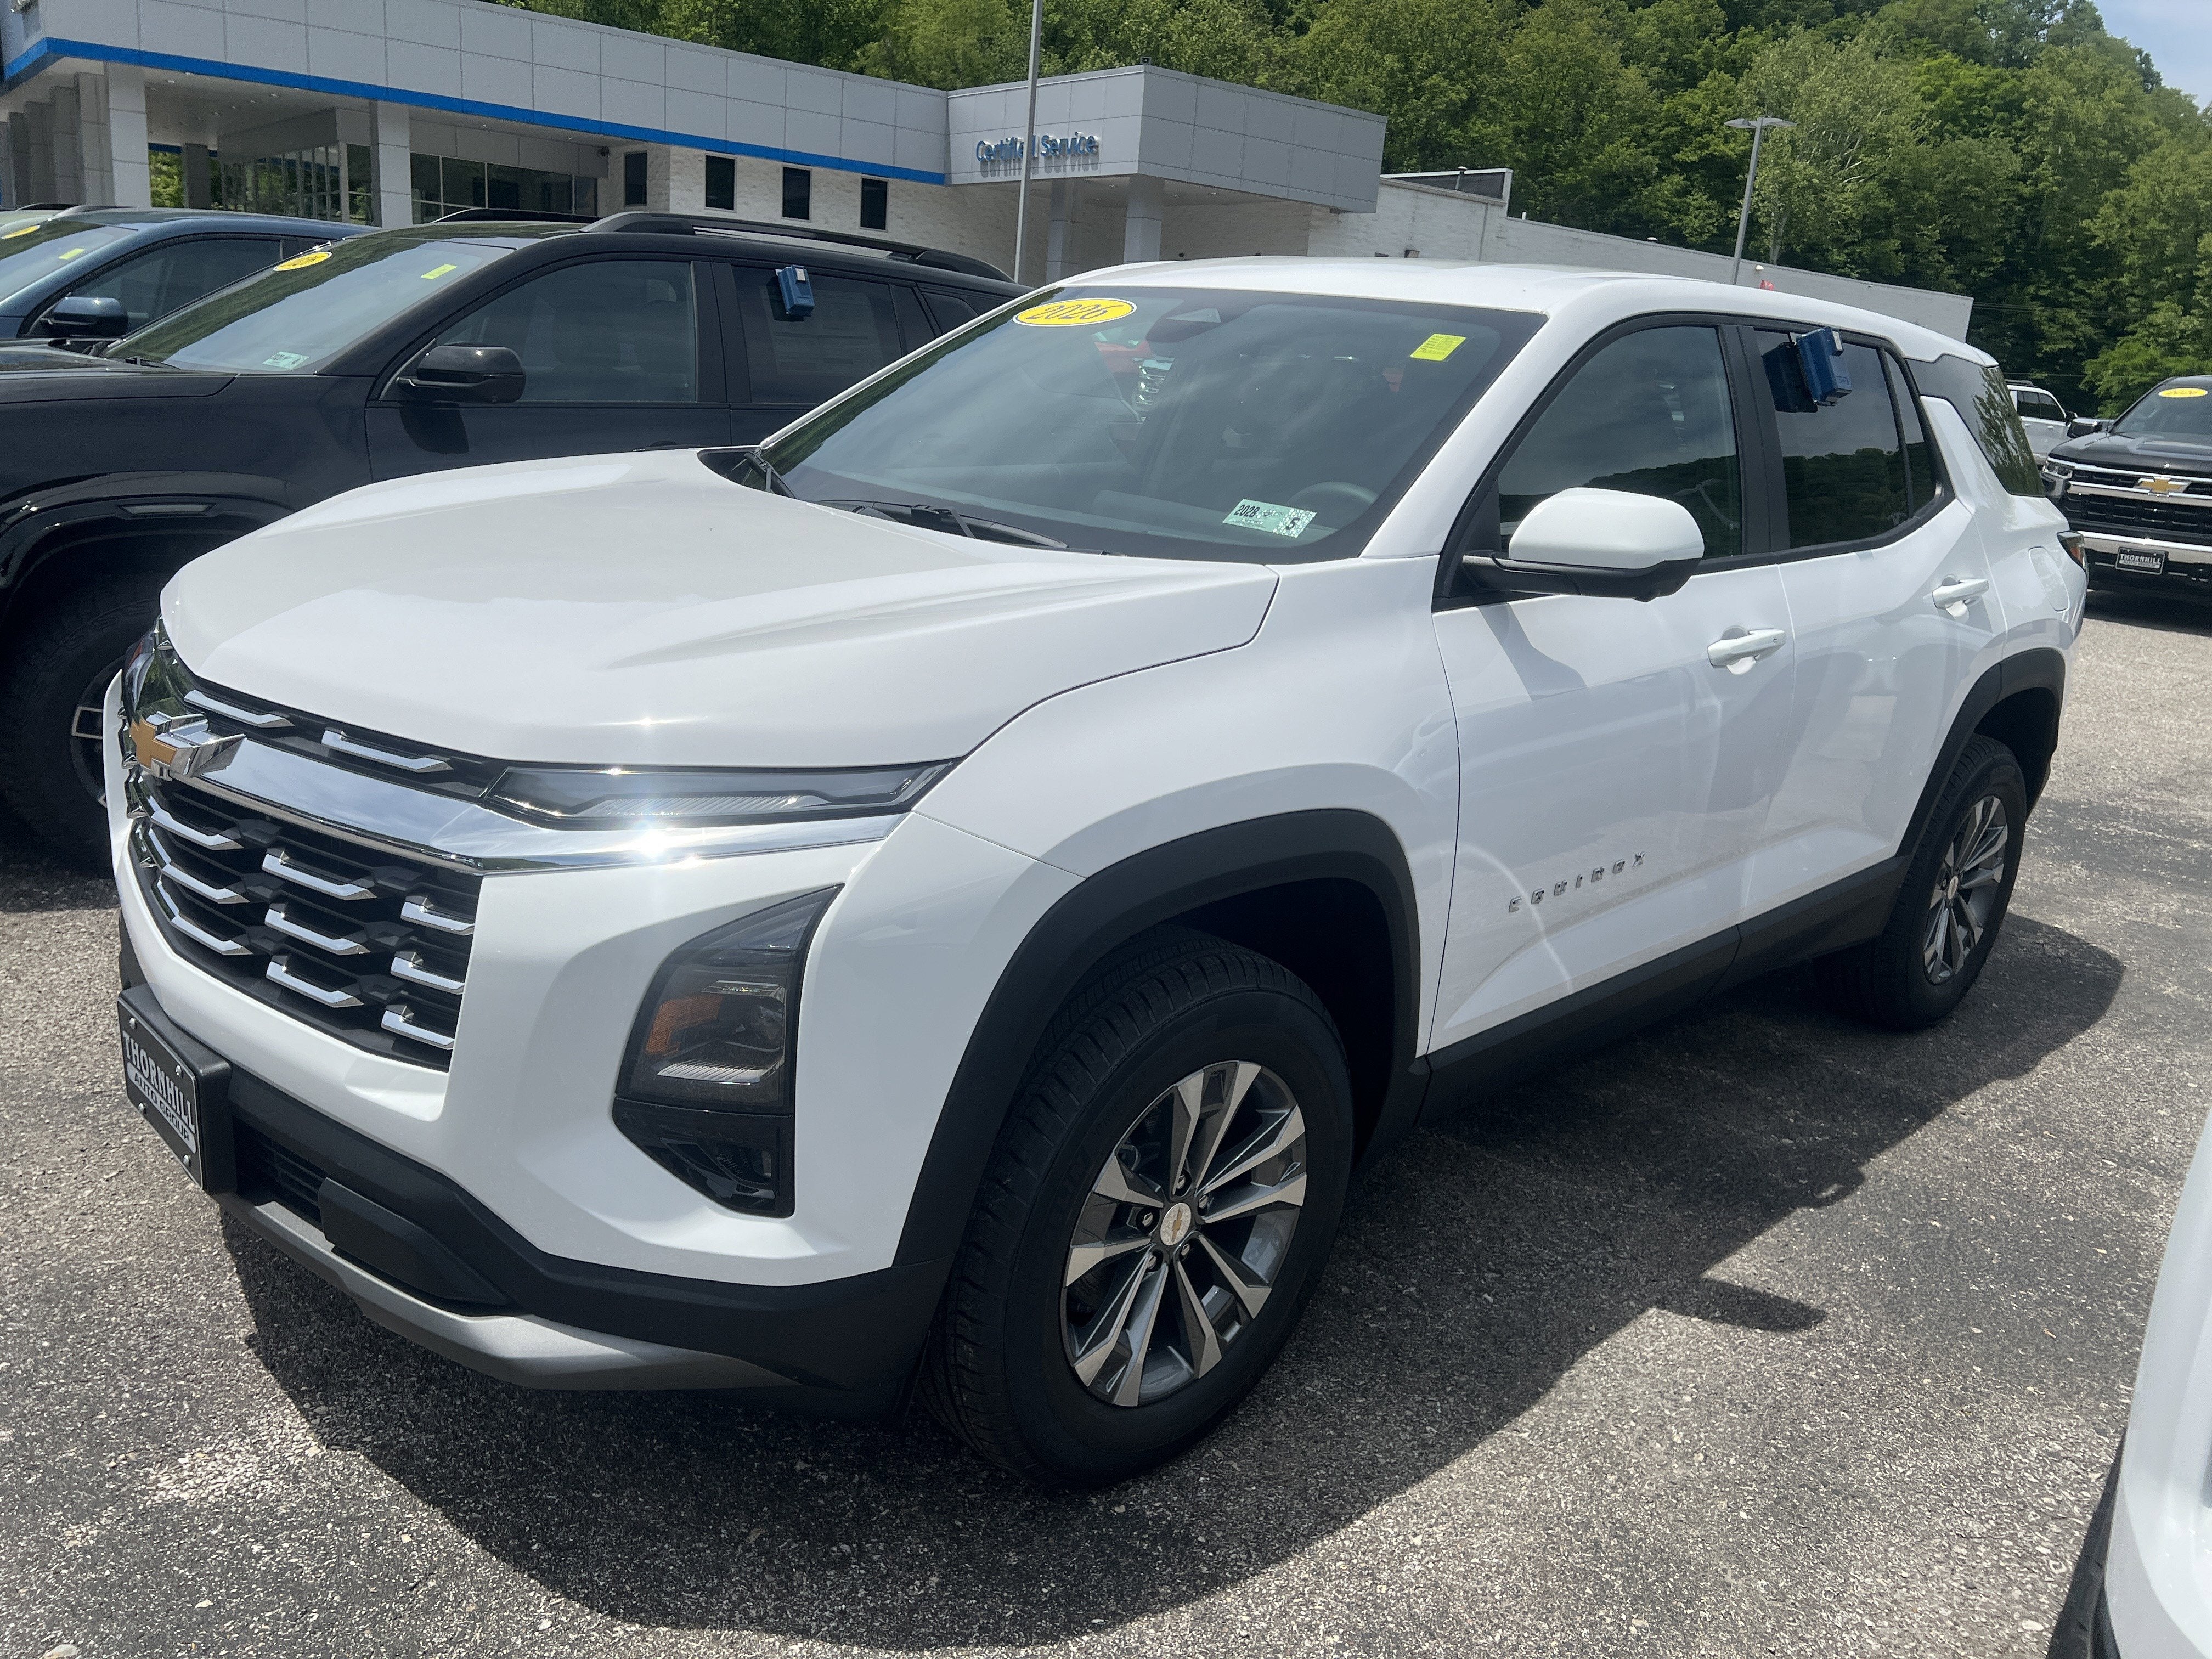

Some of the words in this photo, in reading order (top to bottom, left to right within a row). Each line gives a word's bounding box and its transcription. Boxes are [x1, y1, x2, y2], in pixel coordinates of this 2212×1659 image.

[1041, 131, 1099, 157] Service
[1024, 304, 1124, 320] 2026
[1234, 504, 1260, 517] 2028
[1286, 517, 1300, 530] 5
[2120, 554, 2161, 565] THORNHILL
[1509, 851, 1645, 913] EQUINOX
[122, 1030, 195, 1134] THORNHILL
[134, 1072, 157, 1105] AUTO
[160, 1099, 189, 1141] GROUP
